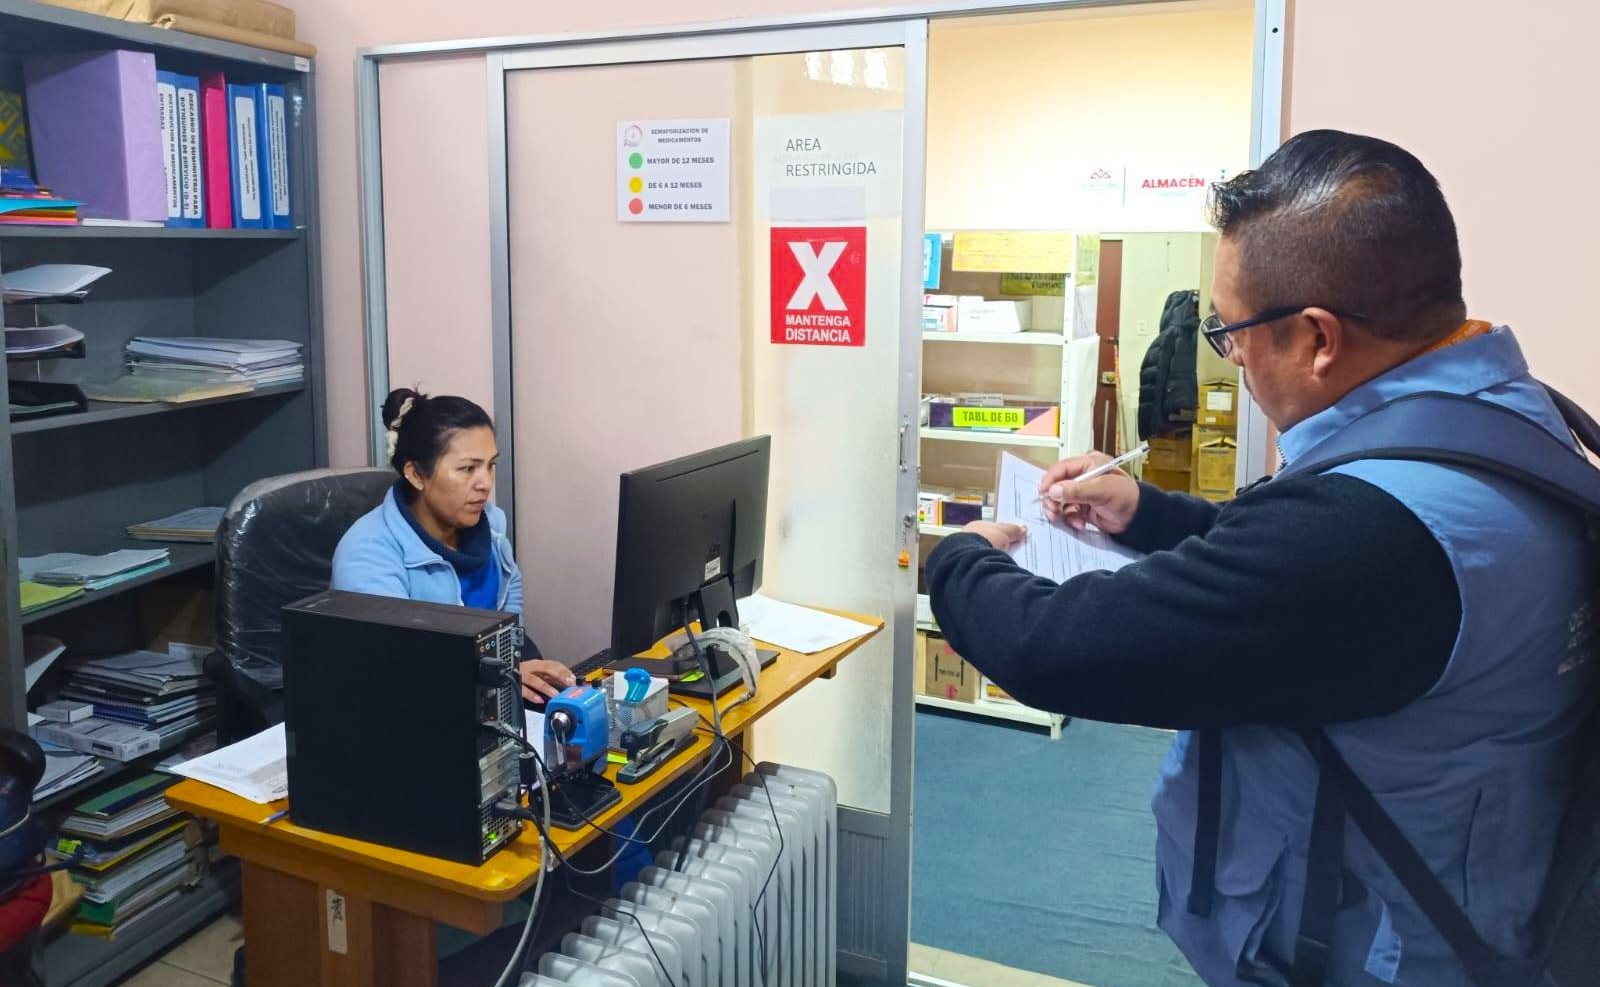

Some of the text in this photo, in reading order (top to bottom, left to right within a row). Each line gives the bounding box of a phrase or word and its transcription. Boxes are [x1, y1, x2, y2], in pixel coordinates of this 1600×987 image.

[785, 138, 821, 151] AREA
[691, 156, 715, 164] MESES
[190, 146, 198, 193] SUMINISTRO
[785, 161, 877, 176] RESTRINGIDA
[1142, 175, 1205, 188] ALMACÉN
[785, 314, 852, 327] MANTENGA
[785, 327, 852, 343] DISTANCIA
[990, 411, 1003, 422] DE
[1004, 412, 1018, 423] 60
